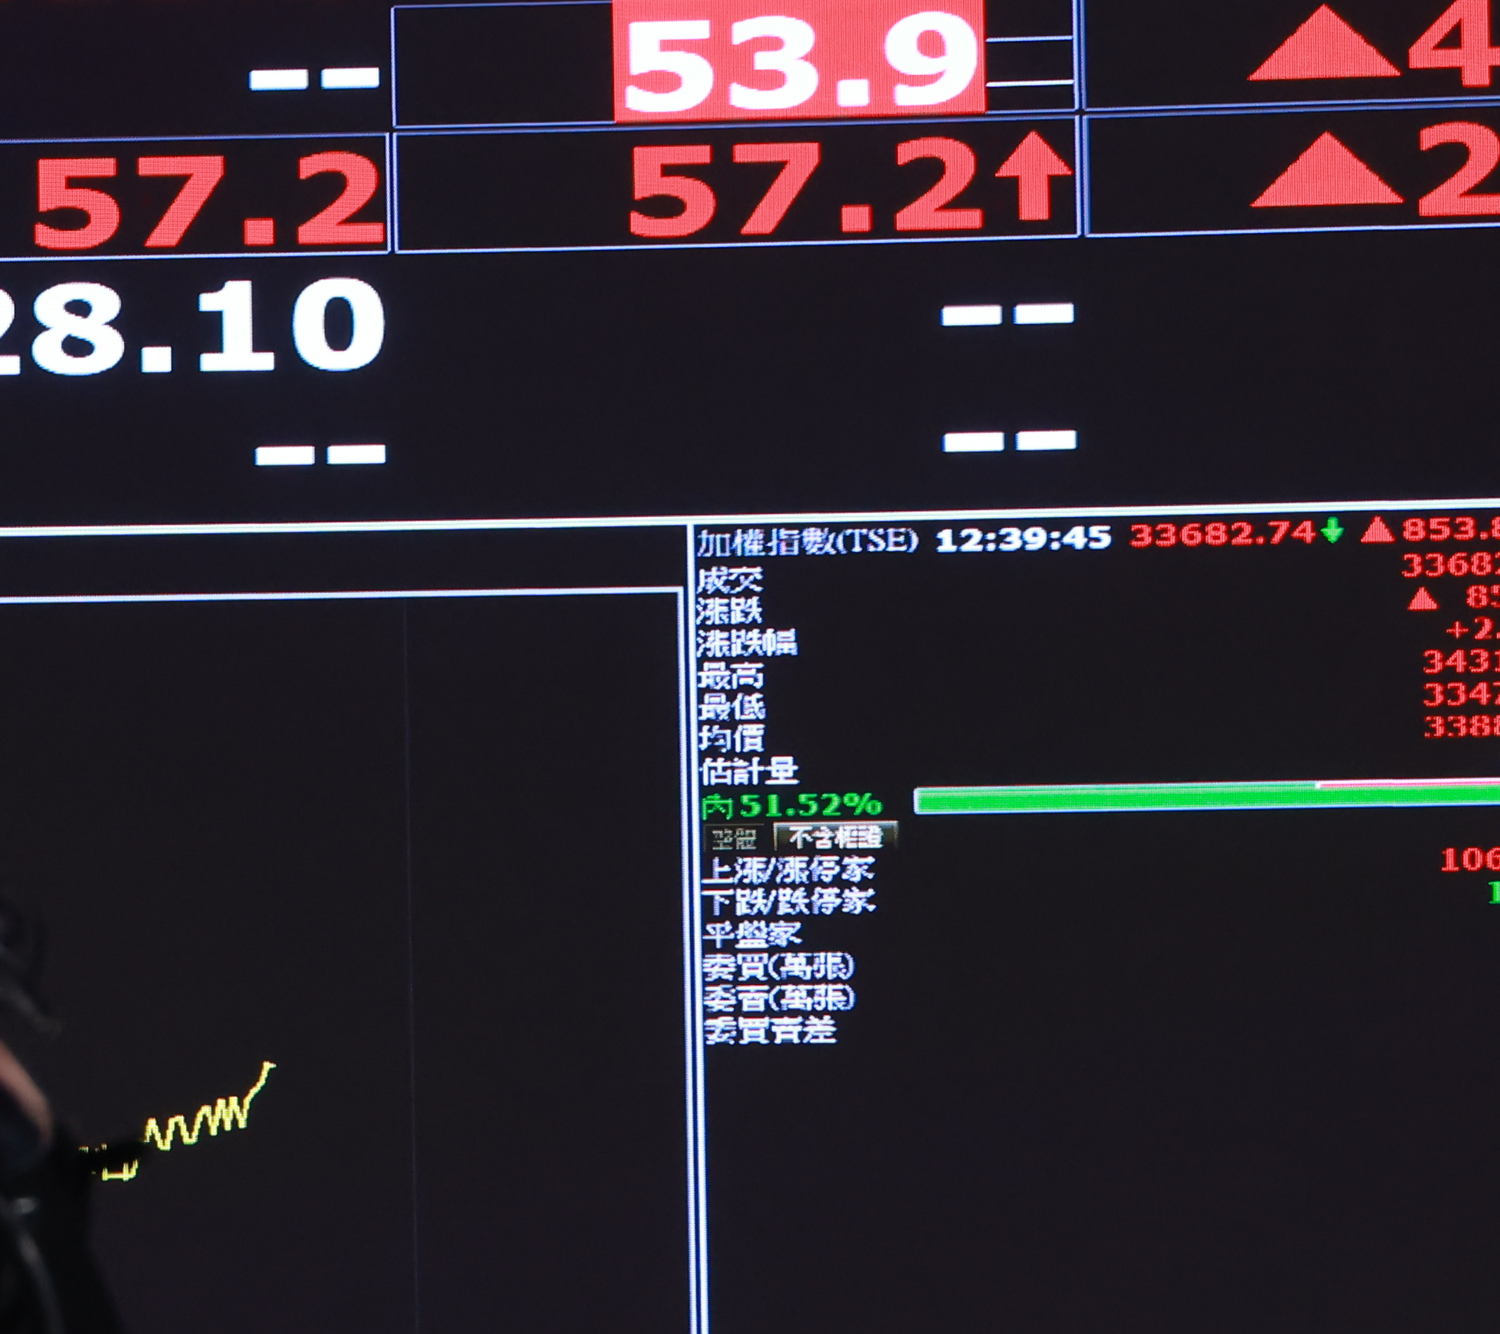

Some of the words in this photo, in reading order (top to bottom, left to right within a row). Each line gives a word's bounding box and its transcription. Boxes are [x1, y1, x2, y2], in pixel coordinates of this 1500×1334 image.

[626, 11, 977, 112] 53.9
[937, 526, 1111, 552] 12:39:45
[1129, 520, 1317, 548] 33682.74
[697, 566, 763, 594] 成交
[696, 596, 762, 625] 漲跌
[698, 662, 764, 690] 最高
[699, 756, 799, 786] 估計量
[740, 793, 883, 817] 51.52%
